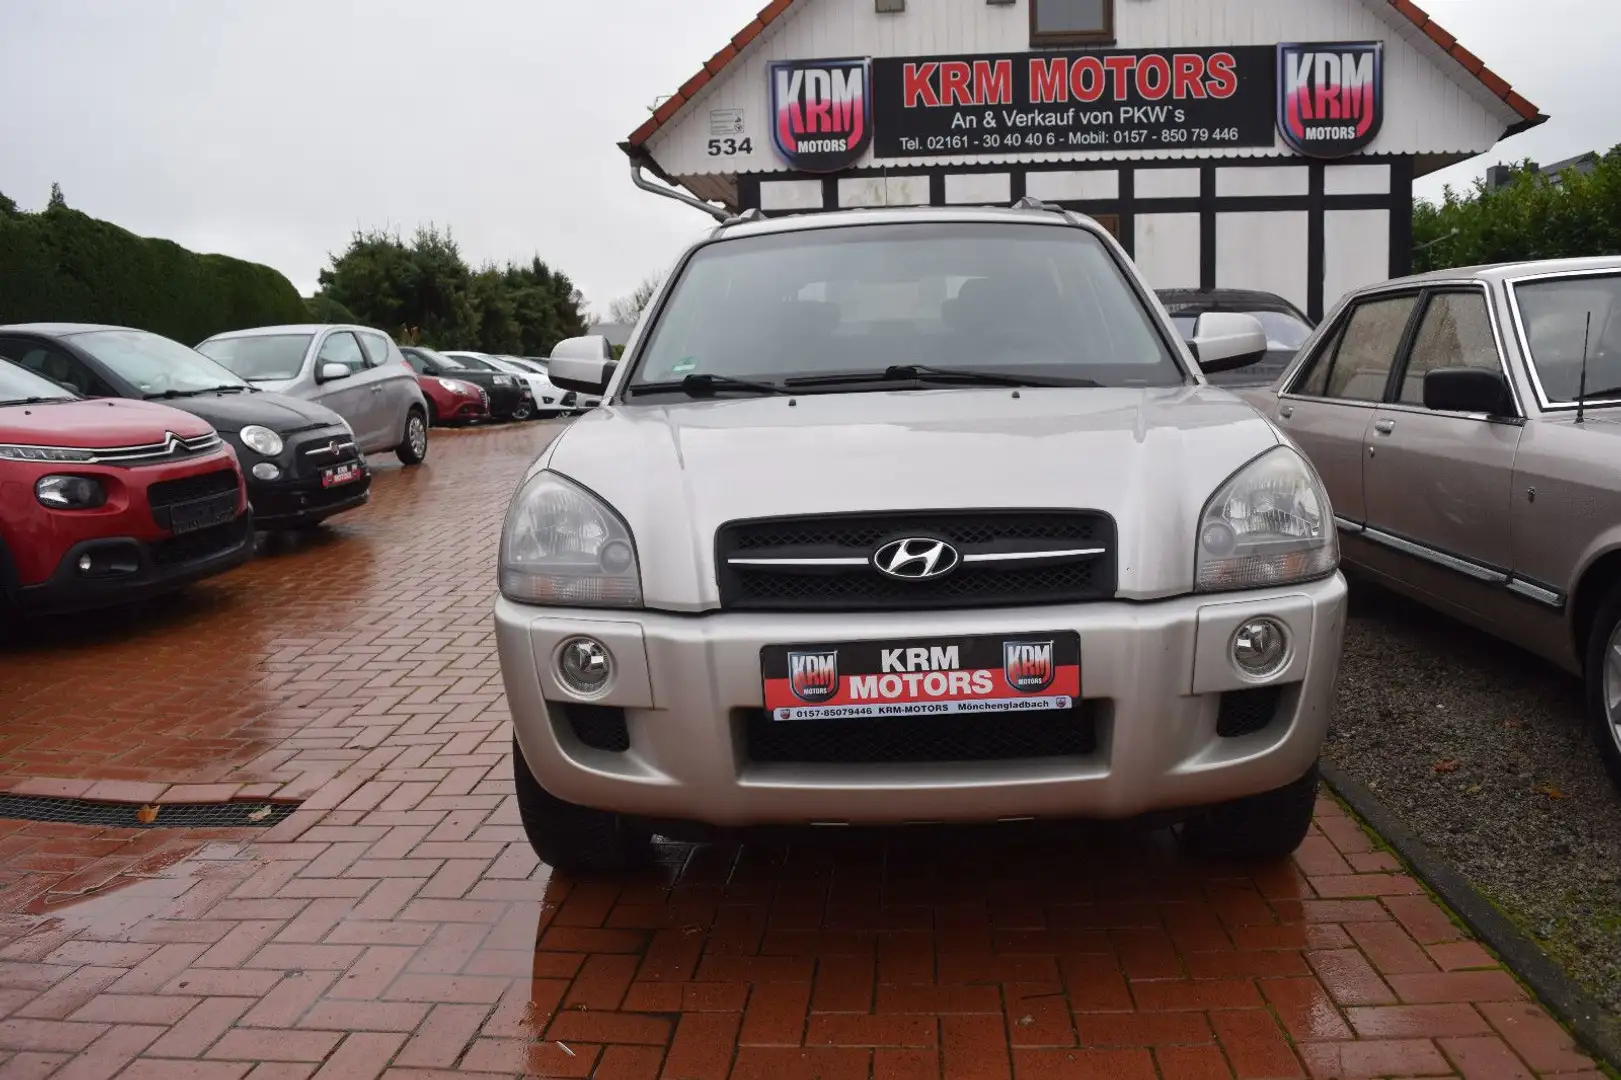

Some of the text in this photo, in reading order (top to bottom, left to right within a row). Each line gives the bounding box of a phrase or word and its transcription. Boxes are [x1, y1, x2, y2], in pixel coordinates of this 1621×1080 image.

[903, 52, 1238, 108] KRM MOTORS
[1286, 52, 1374, 137] KRM
[777, 67, 863, 152] KRM
[951, 112, 977, 129] An
[983, 111, 997, 128] &
[1002, 108, 1075, 127] Verkauf
[1080, 110, 1113, 125] von
[708, 137, 753, 156] 534
[797, 139, 847, 153] MOTORS
[900, 137, 923, 150] Tel.
[927, 135, 968, 149] 02161
[983, 135, 1000, 147] 30
[1004, 133, 1021, 146] 40
[1025, 133, 1043, 145] 40
[1046, 132, 1055, 145] 6
[1068, 131, 1109, 144] Mobil:
[1113, 130, 1148, 143] 0157
[1161, 129, 1187, 142] 850
[1192, 128, 1209, 141] 79
[1212, 128, 1238, 140] 446
[1305, 126, 1355, 140] MOTORS
[881, 645, 960, 673] KRM
[1007, 645, 1051, 683] KRM
[791, 655, 835, 693] KRM
[849, 670, 993, 699] MOTORS
[878, 703, 949, 714] KRM-MOTORS
[957, 700, 1050, 711] Mönchengladbach
